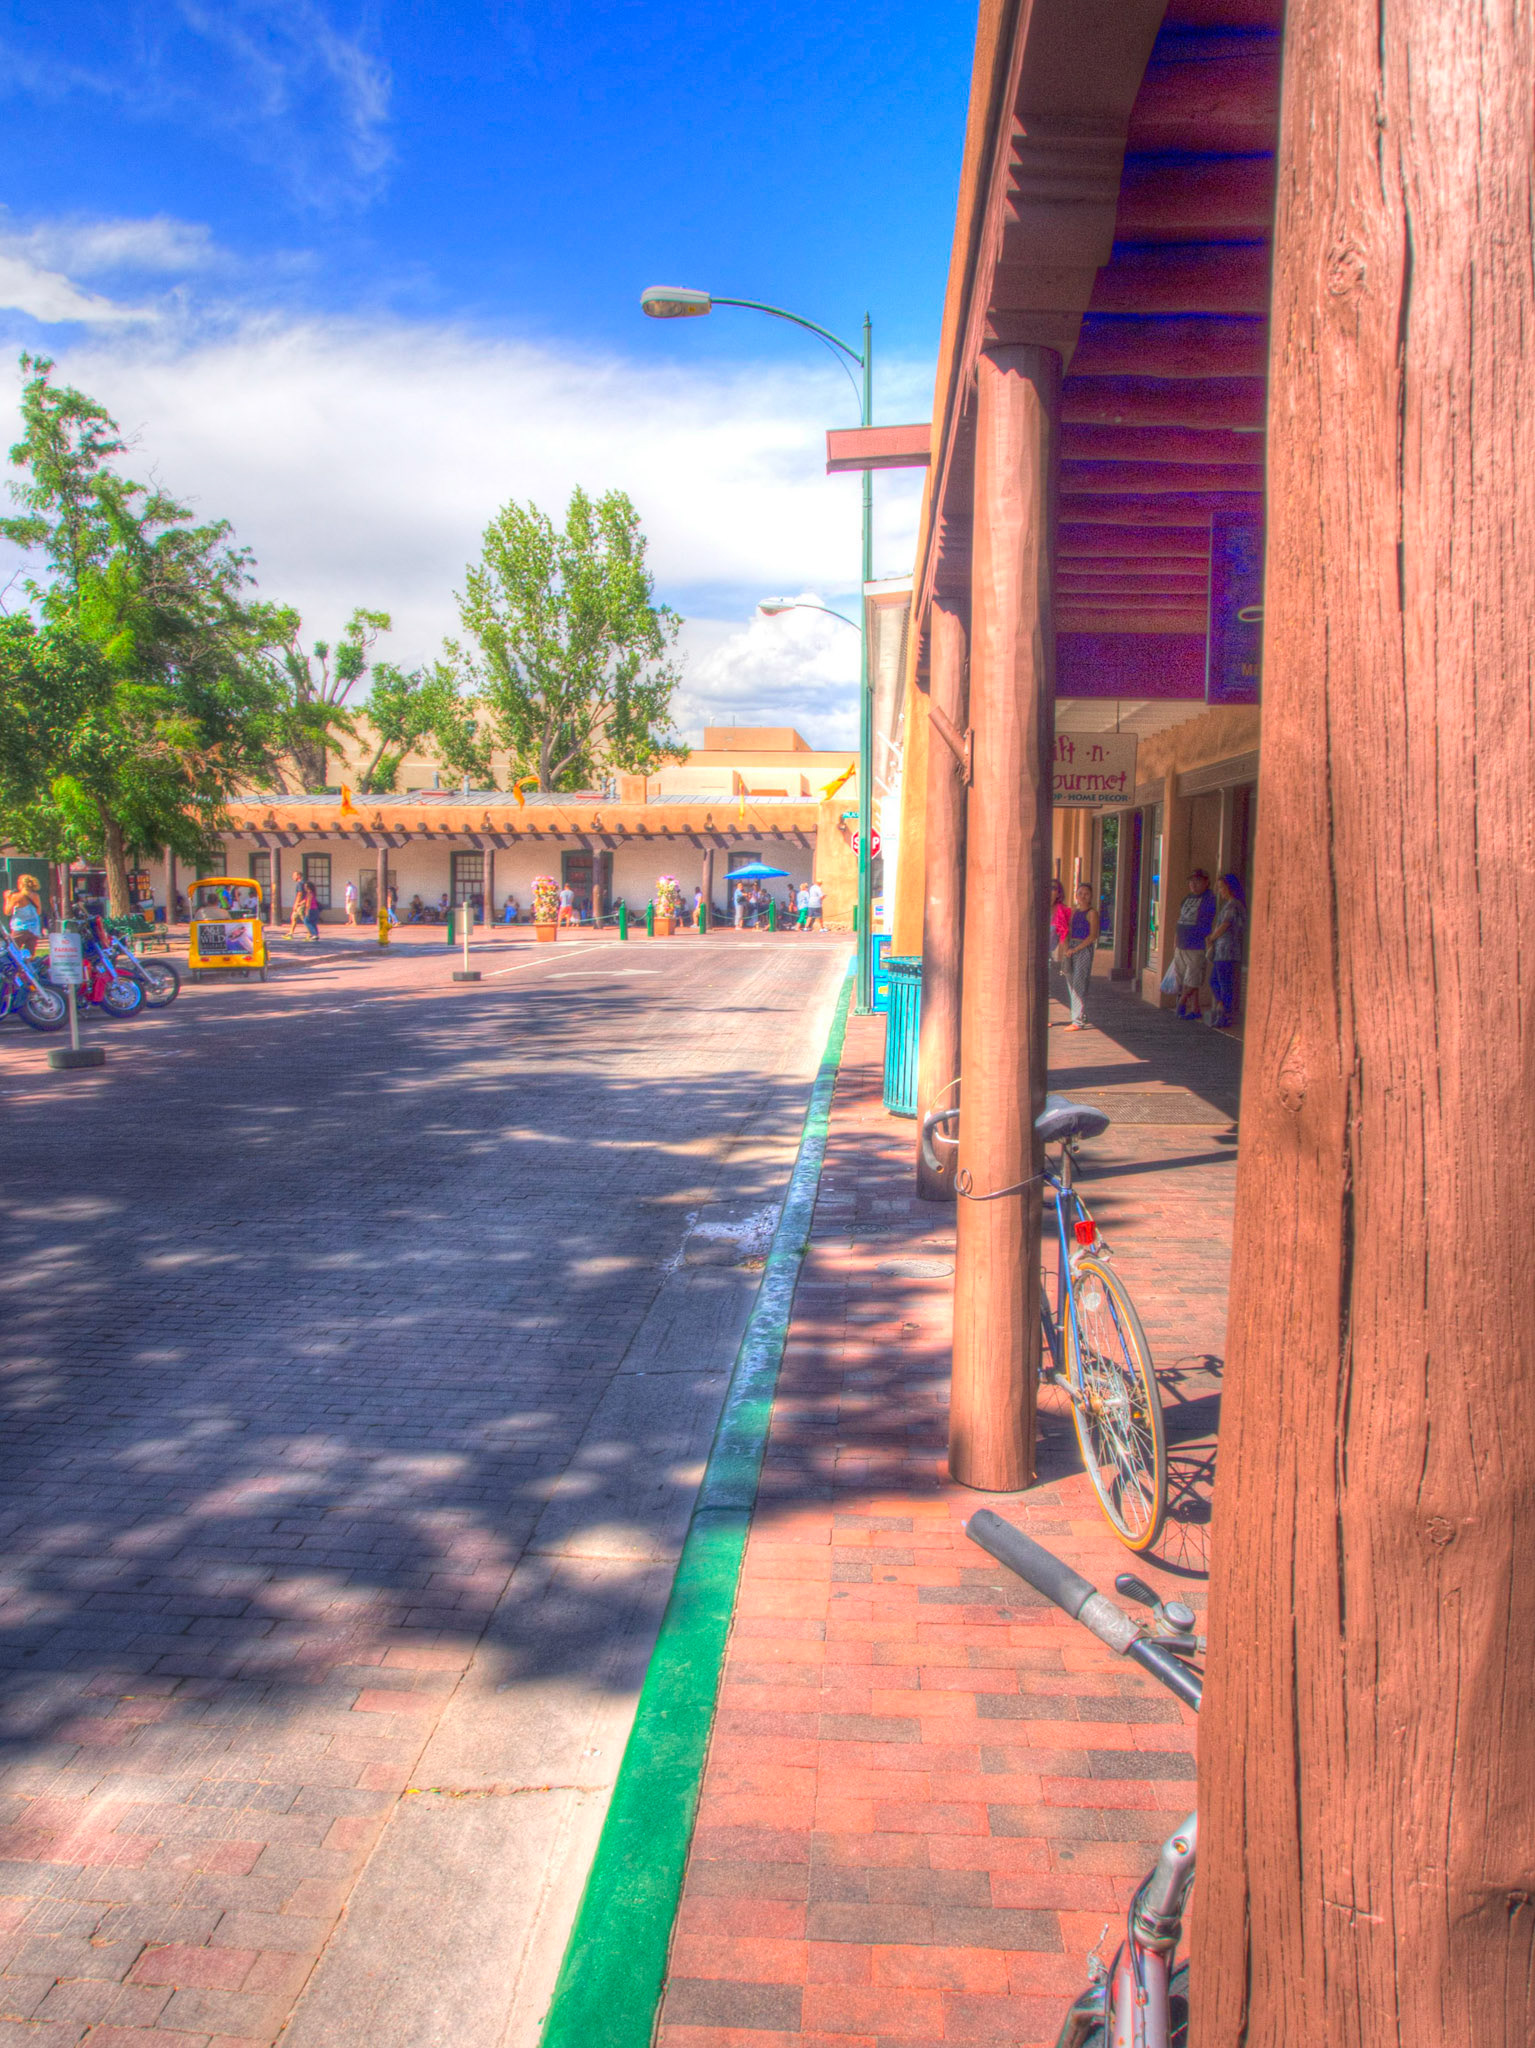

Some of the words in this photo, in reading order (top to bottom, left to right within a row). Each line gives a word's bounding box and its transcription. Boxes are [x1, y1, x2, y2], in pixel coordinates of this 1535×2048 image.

[1054, 735, 1075, 764] ift
[1053, 771, 1126, 792] ourmet
[1067, 793, 1096, 801] HOME
[1098, 793, 1129, 801] DECOR
[853, 836, 880, 849] SP
[200, 934, 226, 944] WILD
